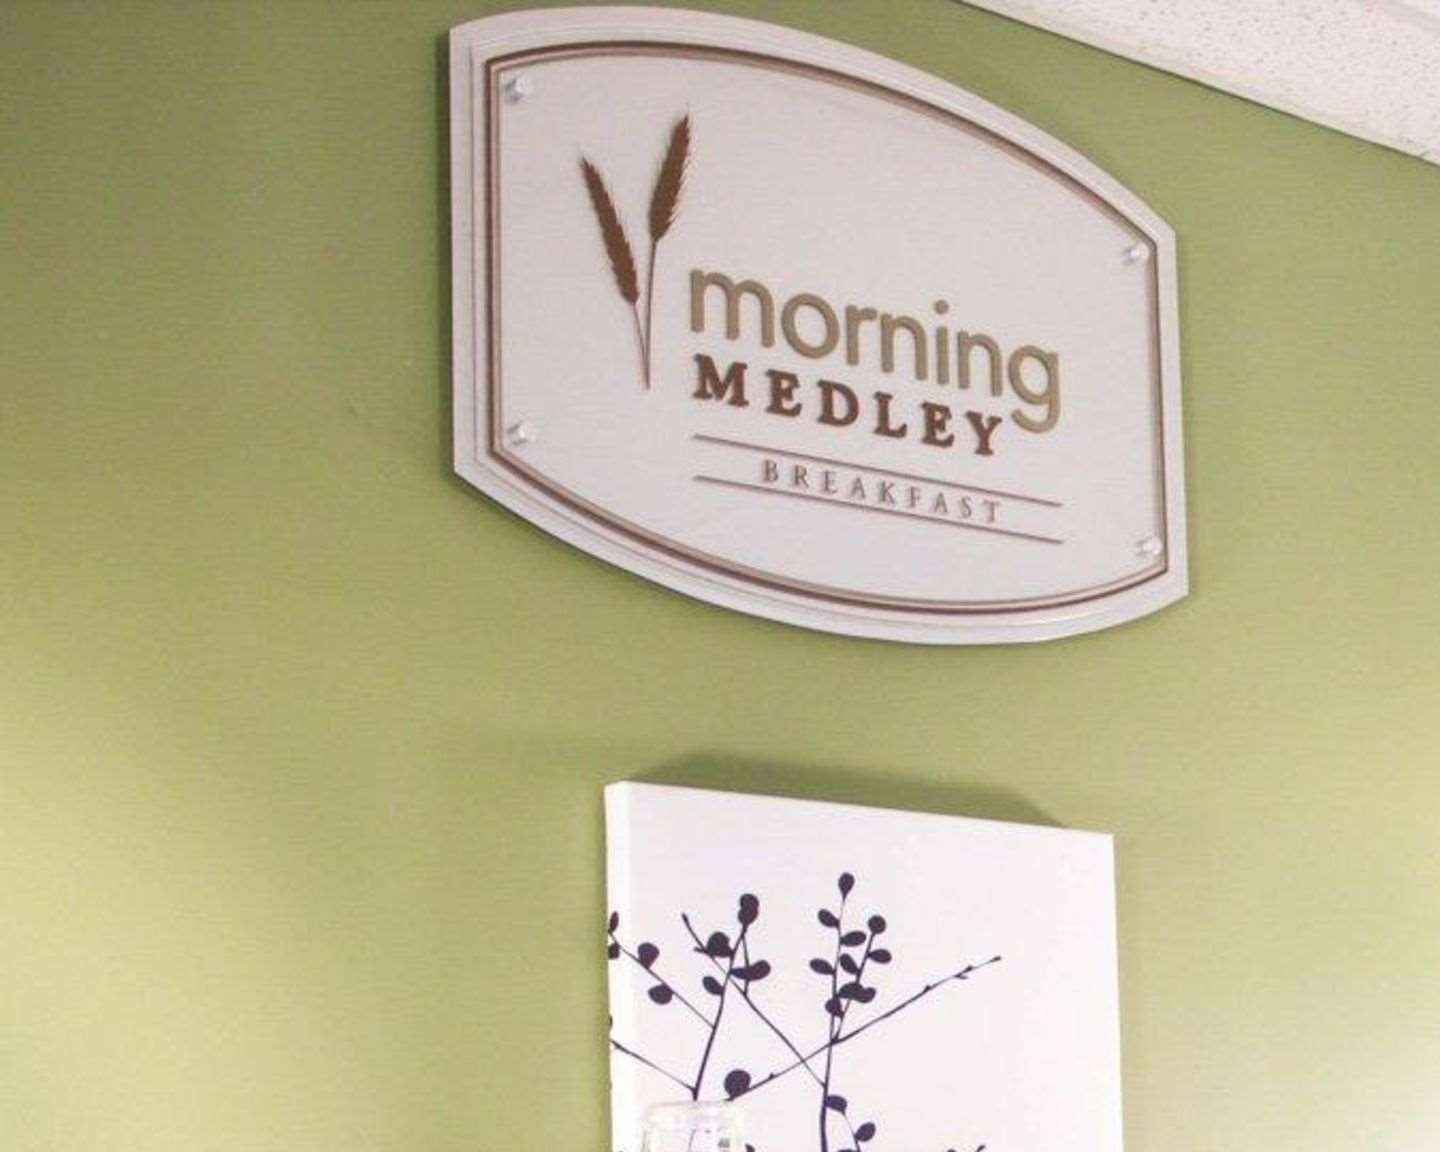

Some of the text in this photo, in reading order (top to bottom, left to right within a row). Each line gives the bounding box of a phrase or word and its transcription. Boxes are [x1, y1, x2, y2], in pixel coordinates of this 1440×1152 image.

[690, 268, 1060, 434] morning
[693, 353, 1003, 456] MEDLEY
[762, 458, 1002, 524] BREAKFAST
